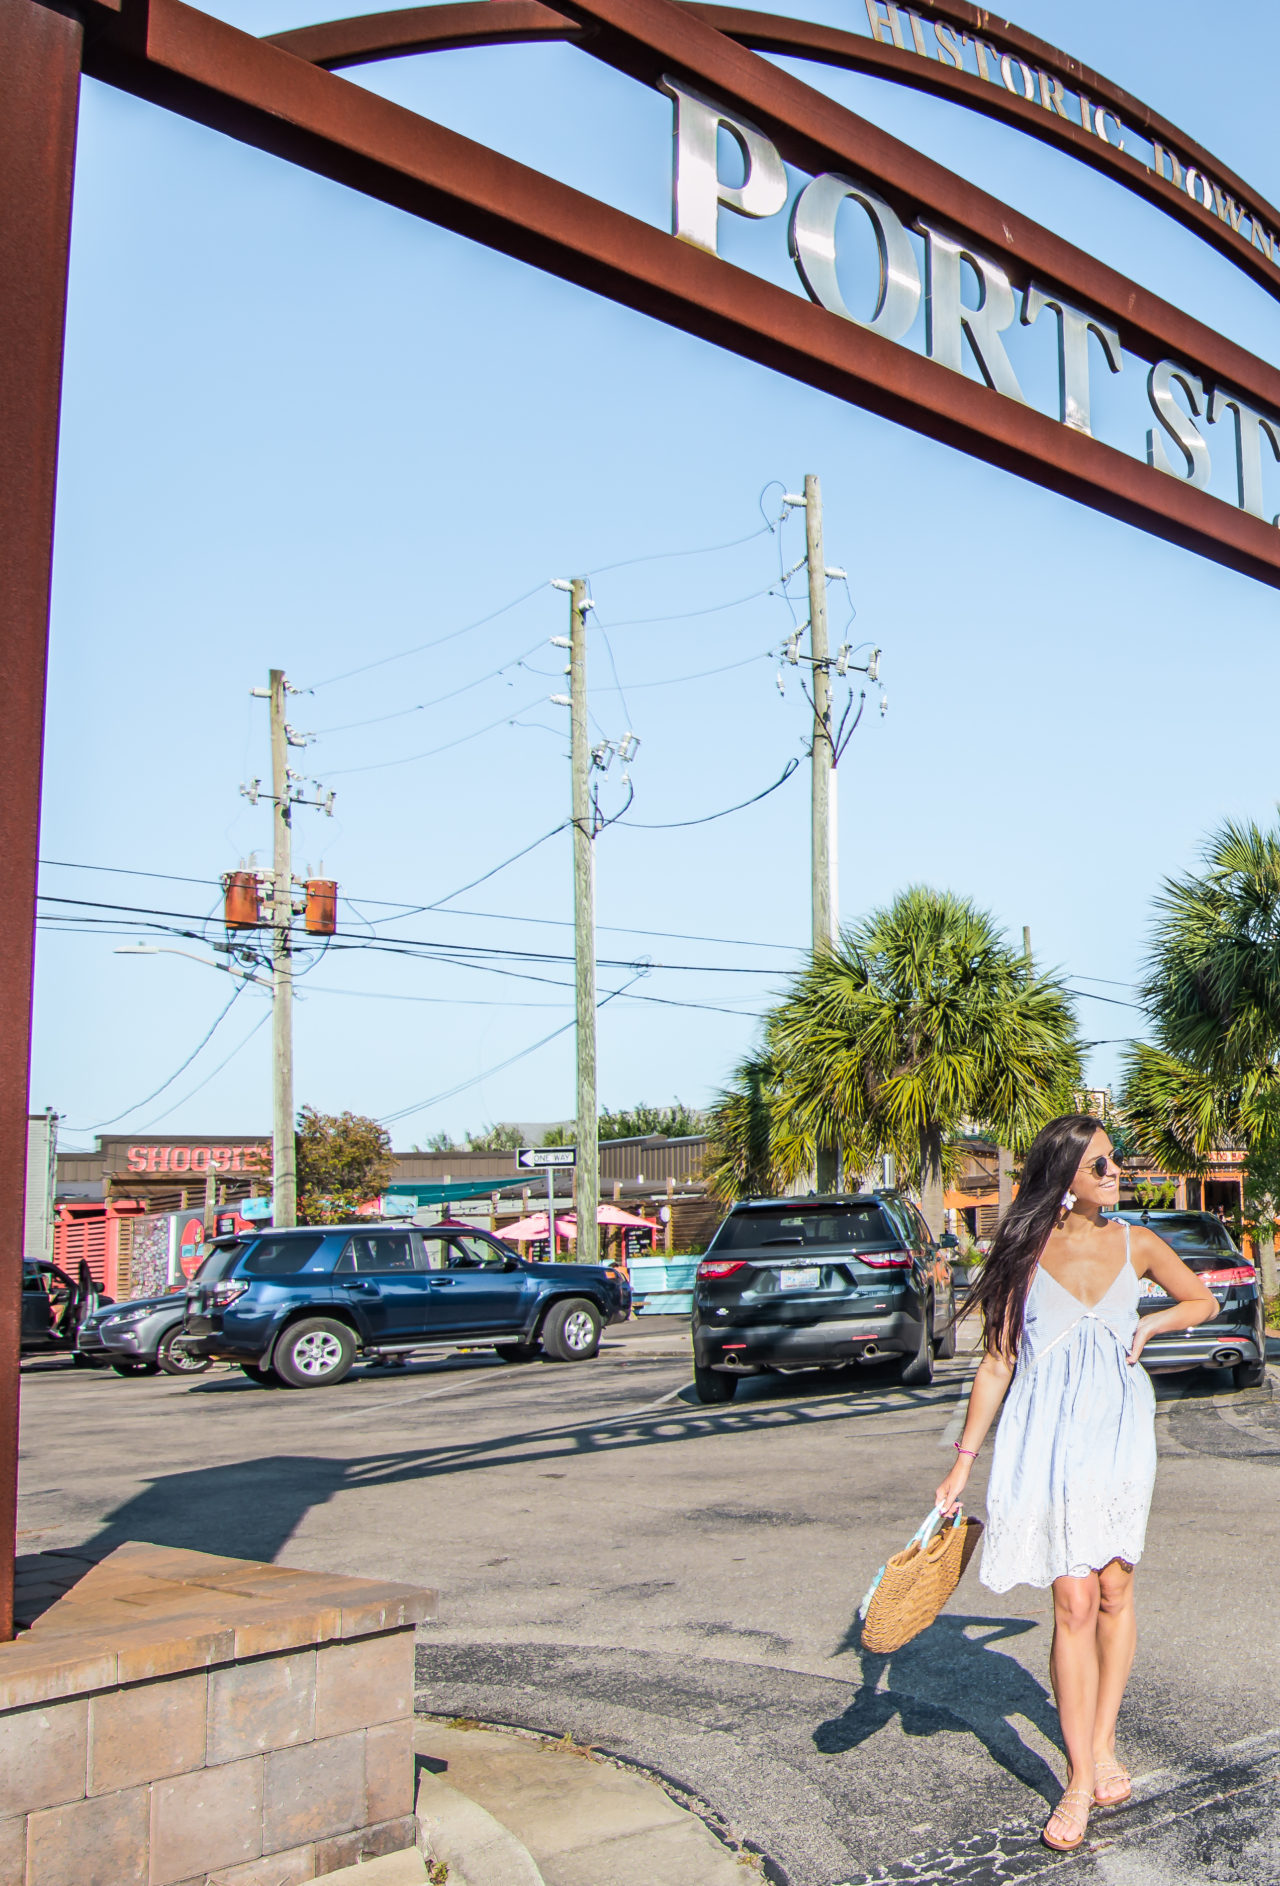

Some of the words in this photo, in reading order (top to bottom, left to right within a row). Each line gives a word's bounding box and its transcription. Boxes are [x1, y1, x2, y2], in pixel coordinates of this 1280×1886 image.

[864, 0, 1123, 151] HISTORIC
[656, 73, 1123, 438] PORT
[534, 1154, 550, 1162] ONE
[554, 1153, 570, 1162] WAY
